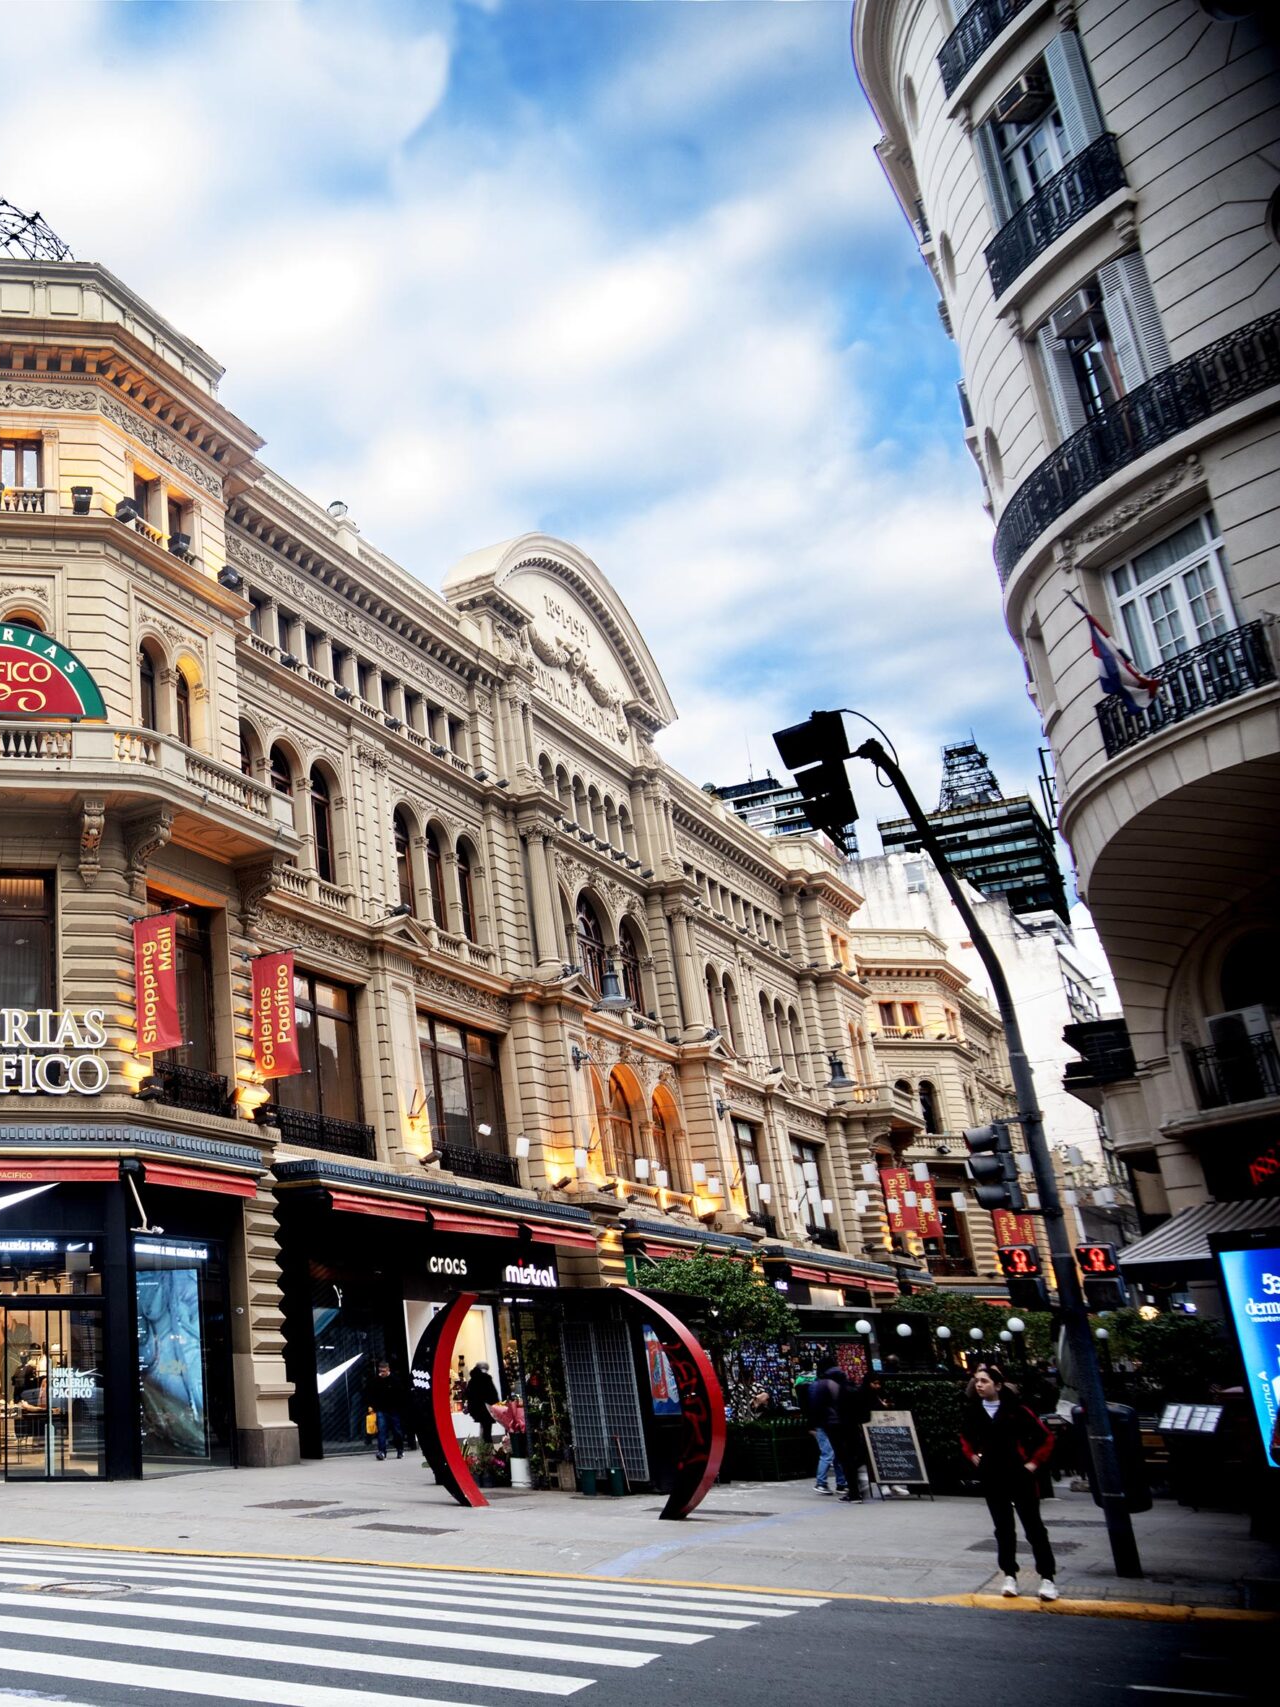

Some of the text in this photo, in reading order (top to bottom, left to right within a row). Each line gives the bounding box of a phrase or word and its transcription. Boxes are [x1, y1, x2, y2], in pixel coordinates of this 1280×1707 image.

[157, 927, 172, 971] Mall
[139, 941, 160, 1044] Shopping
[274, 964, 292, 1043] Pacífico
[258, 986, 276, 1070] Galerías
[428, 1256, 468, 1275] crocs
[504, 1258, 557, 1288] mistral
[52, 1367, 74, 1378] NIKE
